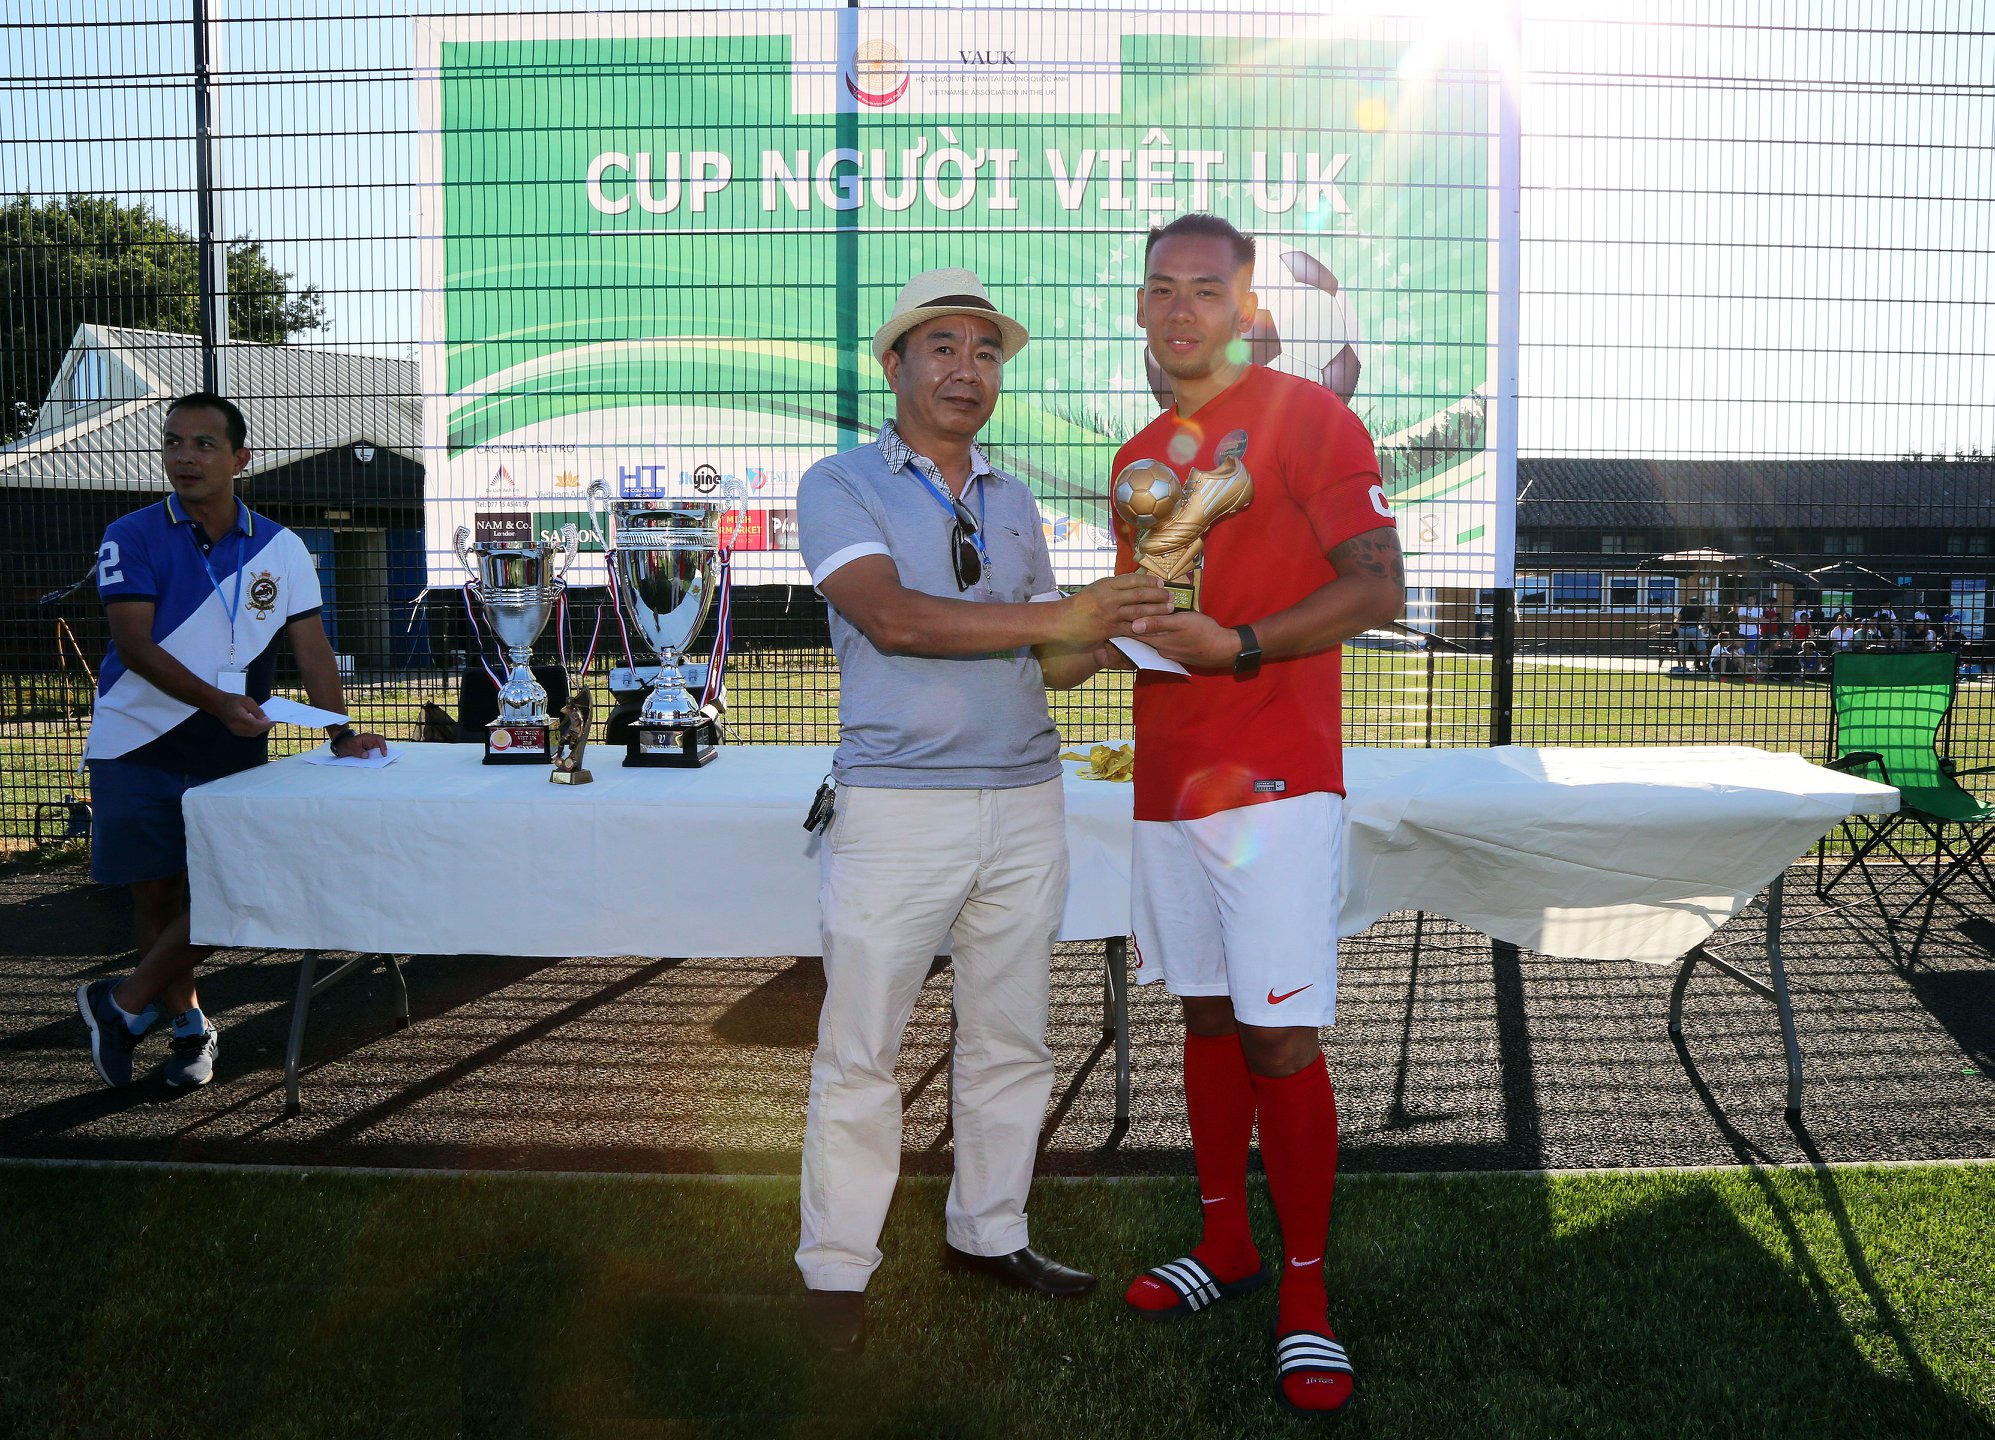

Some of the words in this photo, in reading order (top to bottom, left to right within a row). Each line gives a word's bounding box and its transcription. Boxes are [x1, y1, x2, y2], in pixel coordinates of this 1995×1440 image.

[958, 50, 1016, 65] VAUK
[587, 150, 732, 215] CUP
[762, 127, 1019, 212] NGƯỜI
[1252, 151, 1353, 215] UK
[476, 520, 503, 530] NAM
[505, 520, 514, 530] &
[516, 520, 532, 530] Co.
[541, 529, 604, 543] SAON
[99, 541, 125, 586] 2
